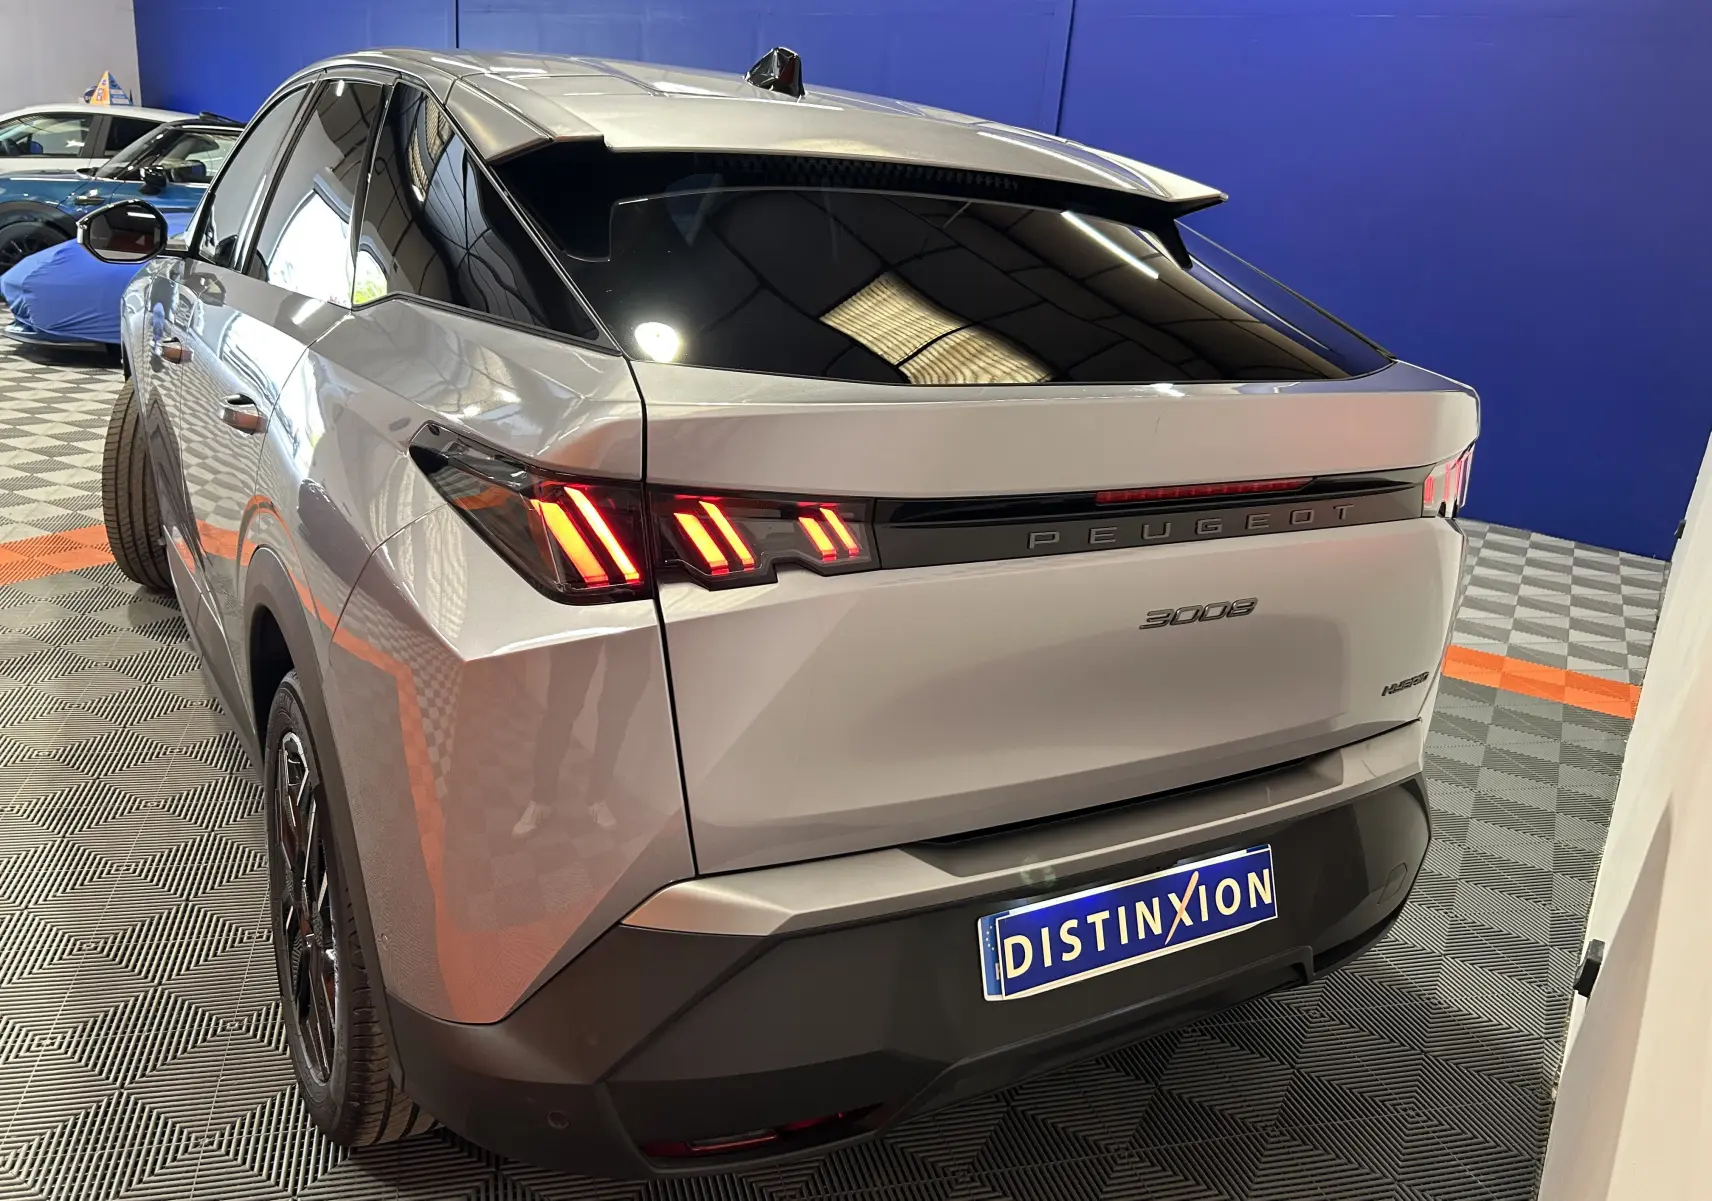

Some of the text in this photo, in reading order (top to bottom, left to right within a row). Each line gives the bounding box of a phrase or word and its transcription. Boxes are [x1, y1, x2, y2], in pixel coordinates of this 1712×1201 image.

[1029, 504, 1354, 549] PEUGEOT
[1139, 597, 1258, 630] 3008
[1003, 869, 1272, 979] DISTINXION
